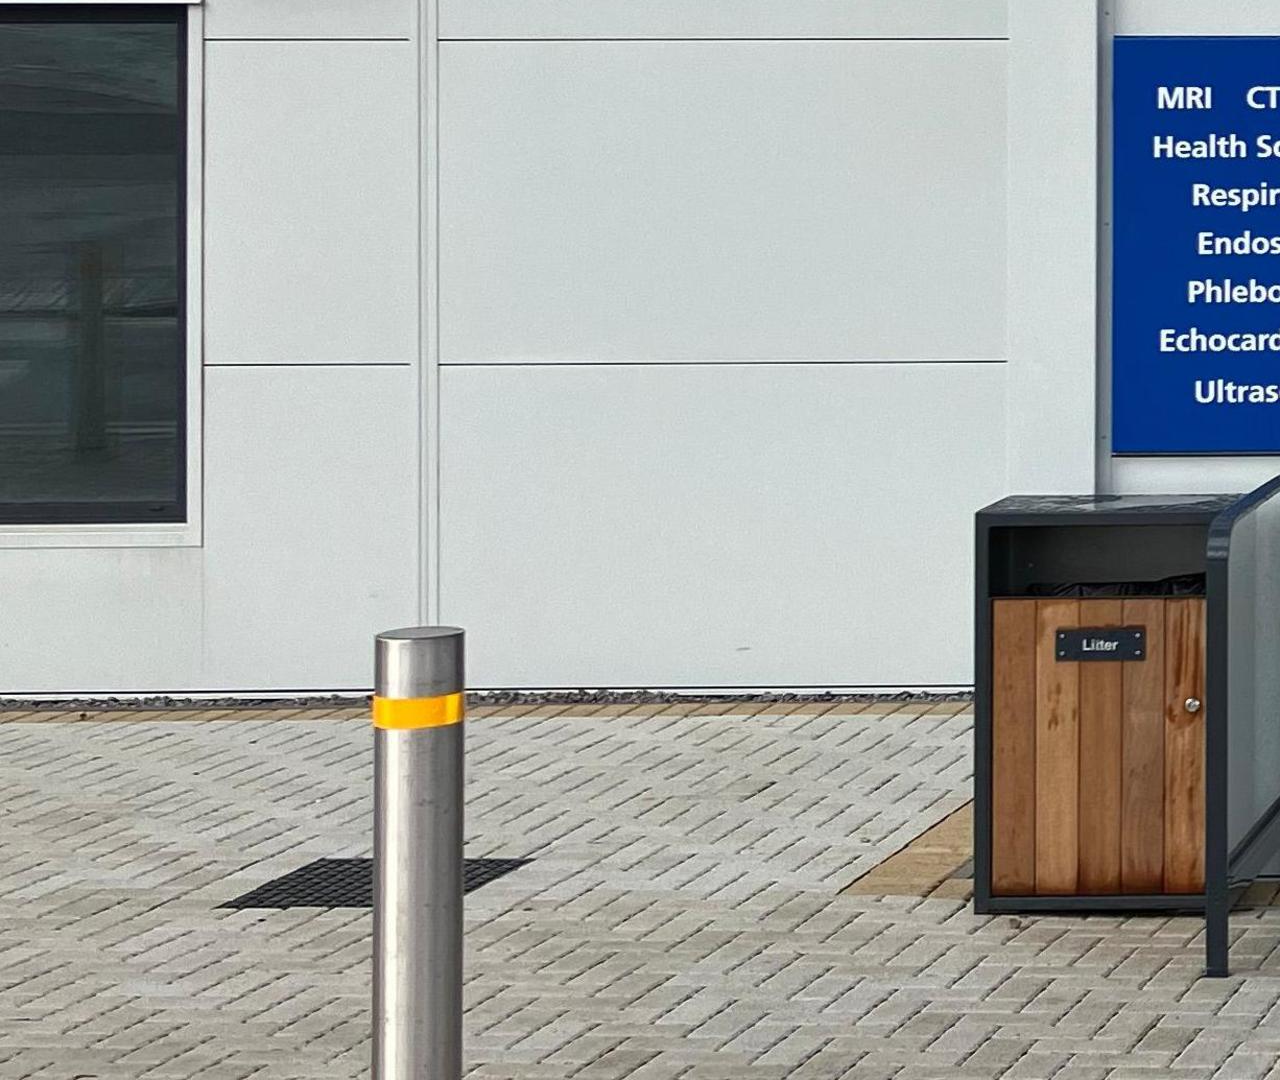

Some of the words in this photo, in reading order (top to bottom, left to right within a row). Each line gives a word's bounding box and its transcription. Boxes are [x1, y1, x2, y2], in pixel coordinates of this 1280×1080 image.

[1157, 86, 1212, 109] MRI
[1153, 133, 1247, 159] Health
[1082, 639, 1120, 651] Litter
